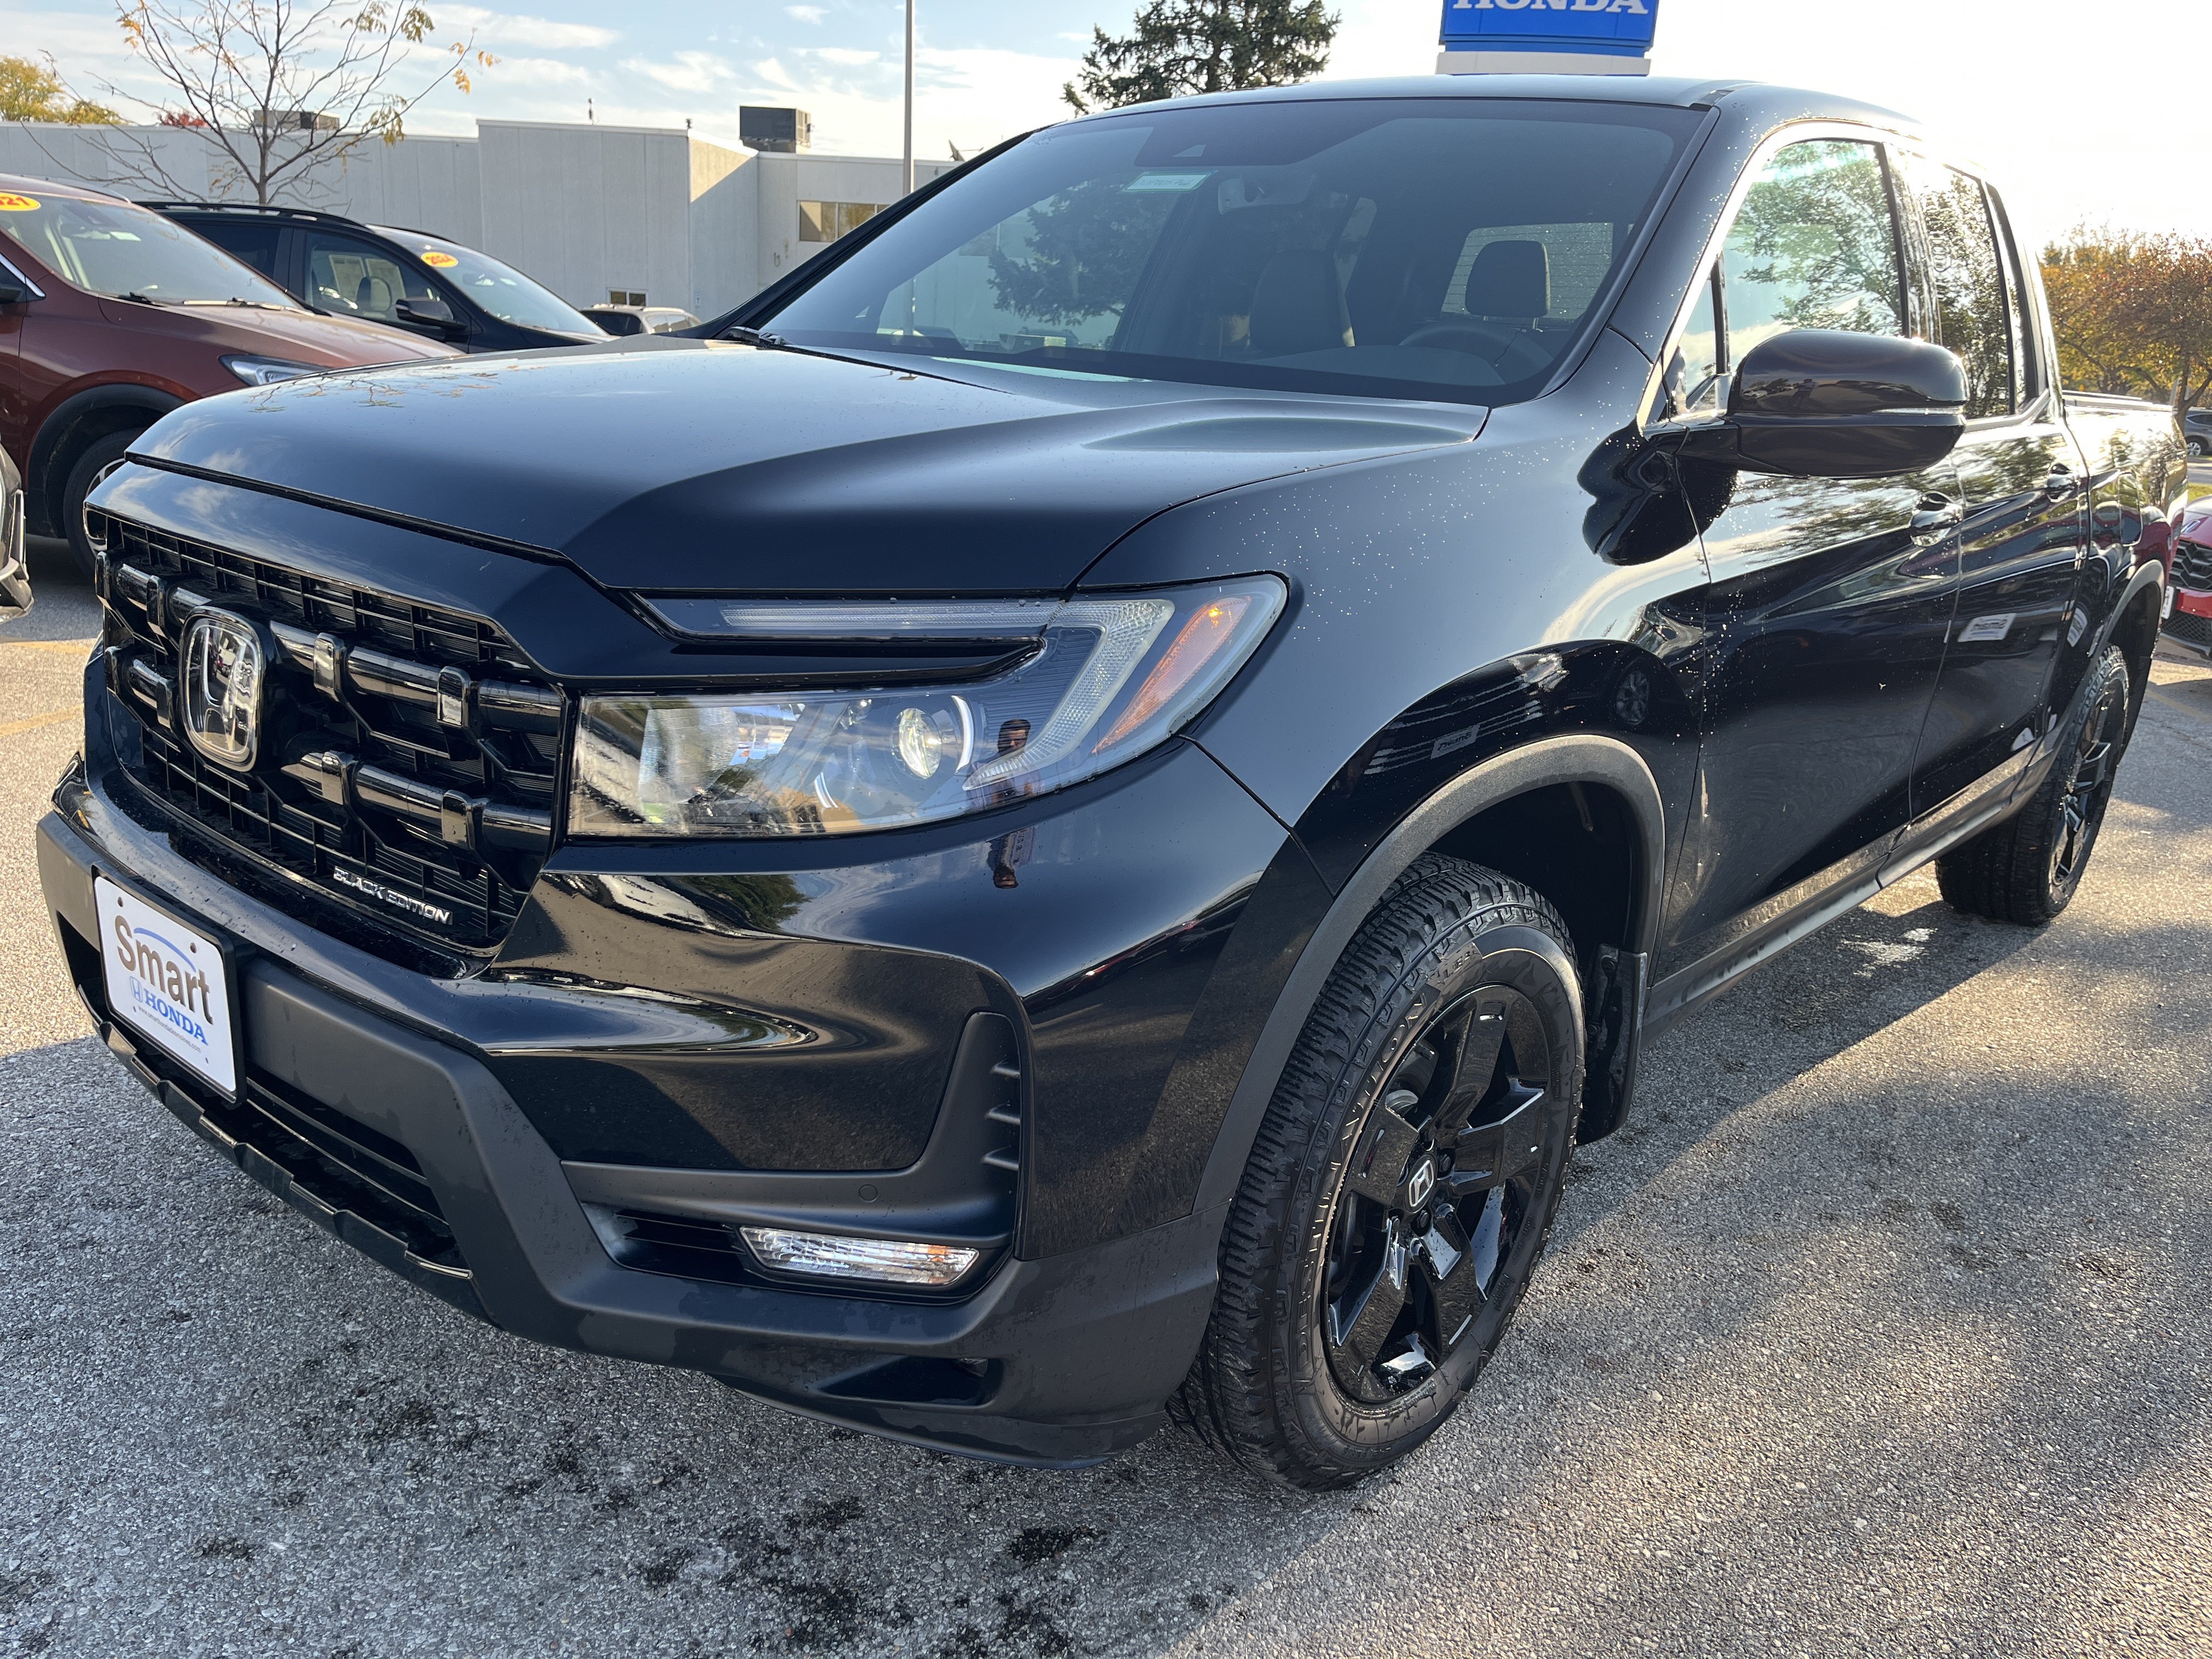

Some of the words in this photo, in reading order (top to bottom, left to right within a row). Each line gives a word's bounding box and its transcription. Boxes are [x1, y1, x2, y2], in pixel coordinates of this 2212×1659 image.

[334, 866, 386, 900] BLACK
[386, 889, 451, 924] EDITION
[115, 915, 214, 1025] Smart
[144, 988, 208, 1046] HONDA
